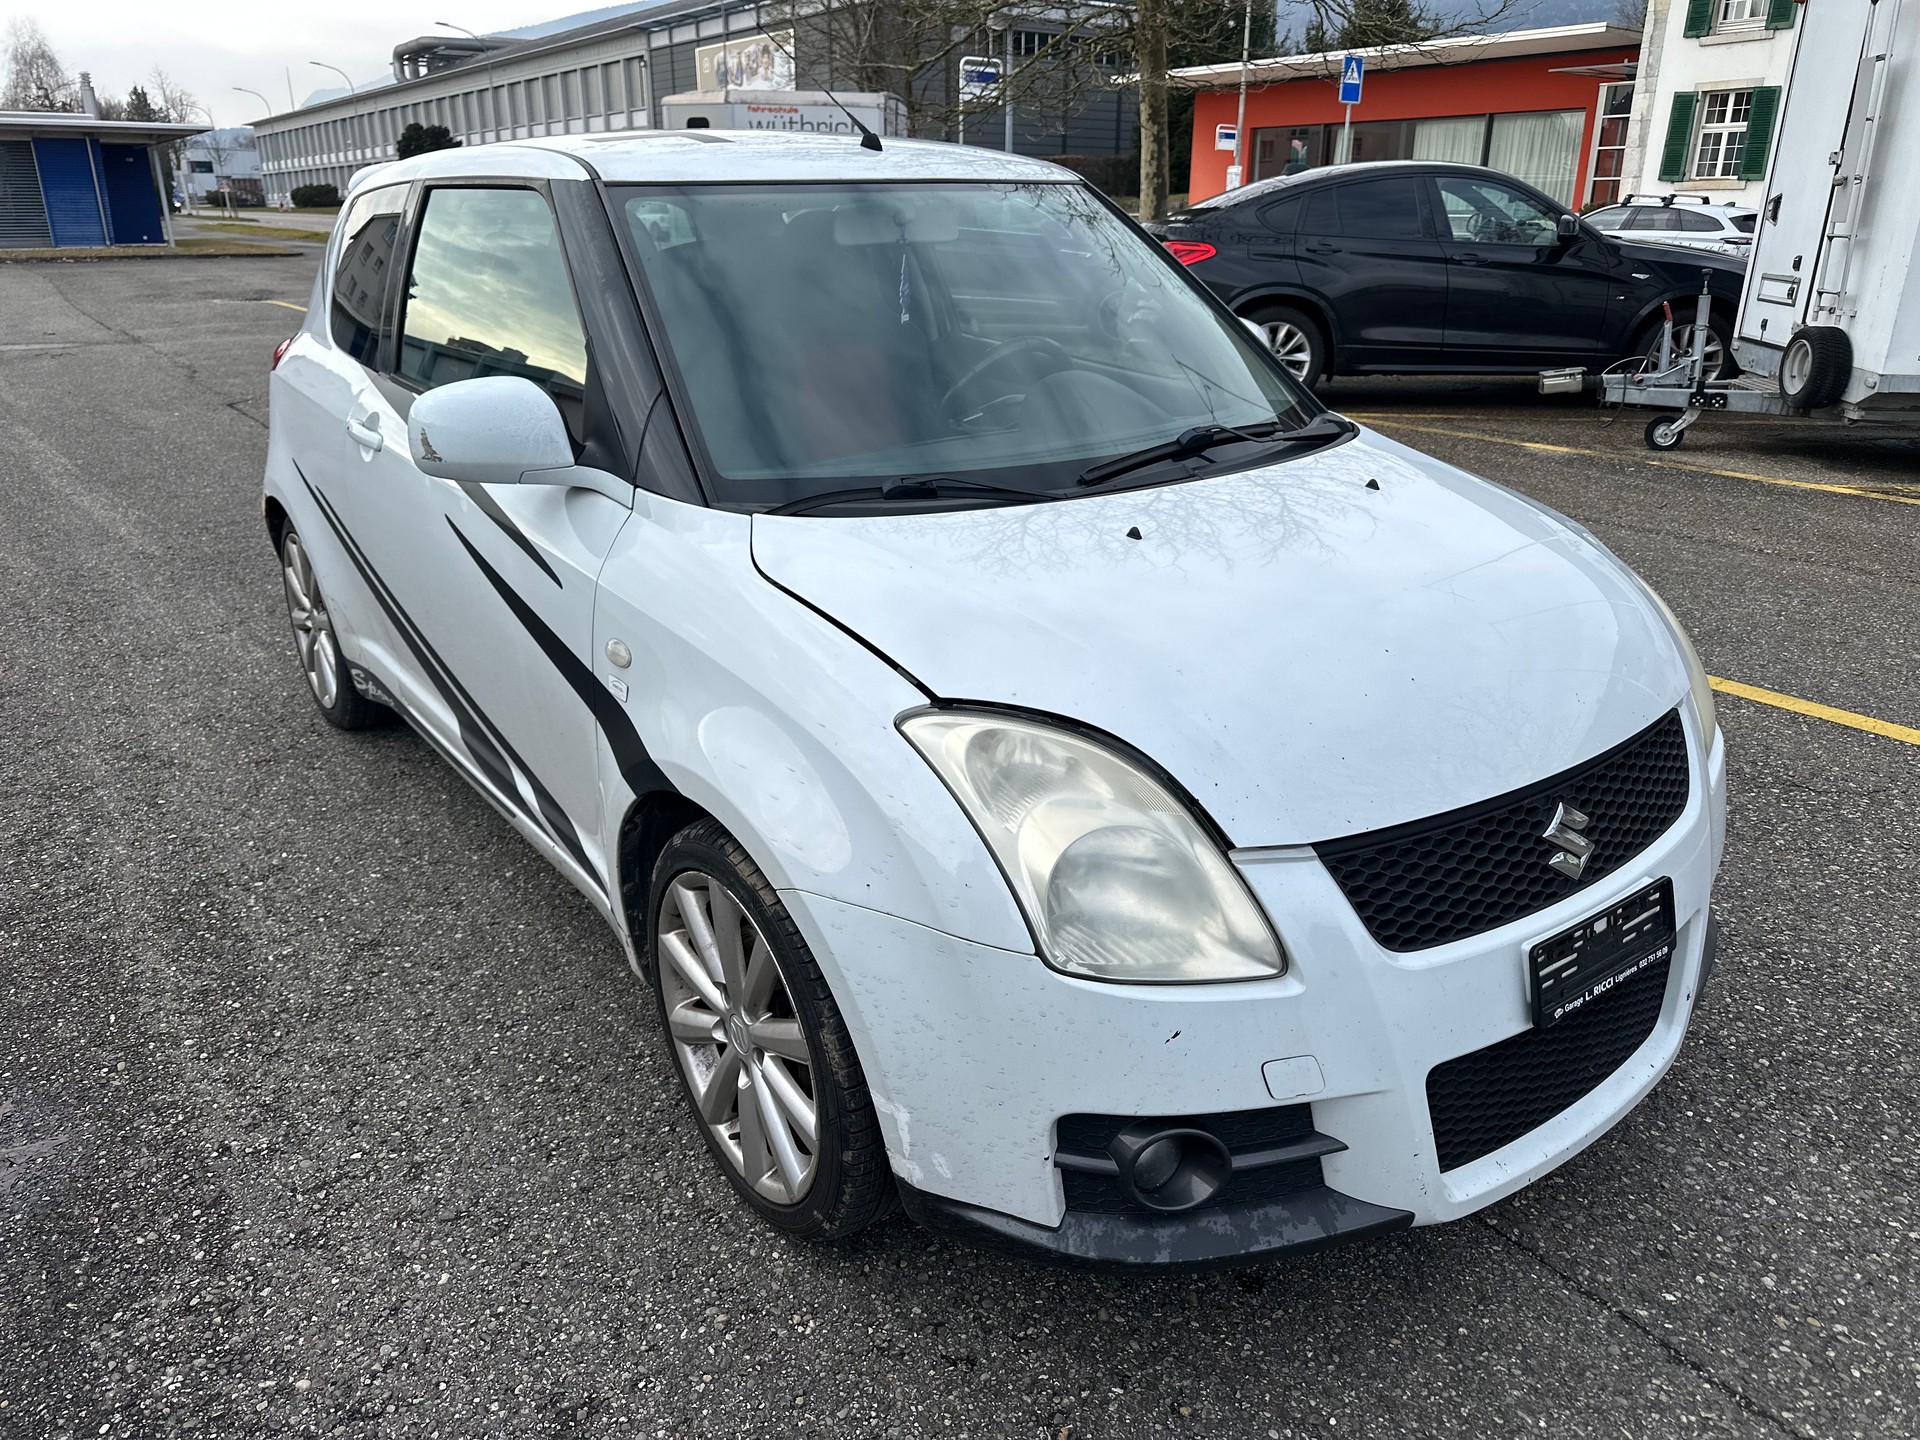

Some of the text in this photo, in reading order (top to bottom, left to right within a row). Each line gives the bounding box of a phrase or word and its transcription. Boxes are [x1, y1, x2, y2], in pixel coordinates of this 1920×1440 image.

[1564, 997, 1584, 1012] Garage
[1585, 991, 1593, 1001] L.
[1593, 976, 1613, 997] RICCI
[1647, 953, 1656, 963] 751
